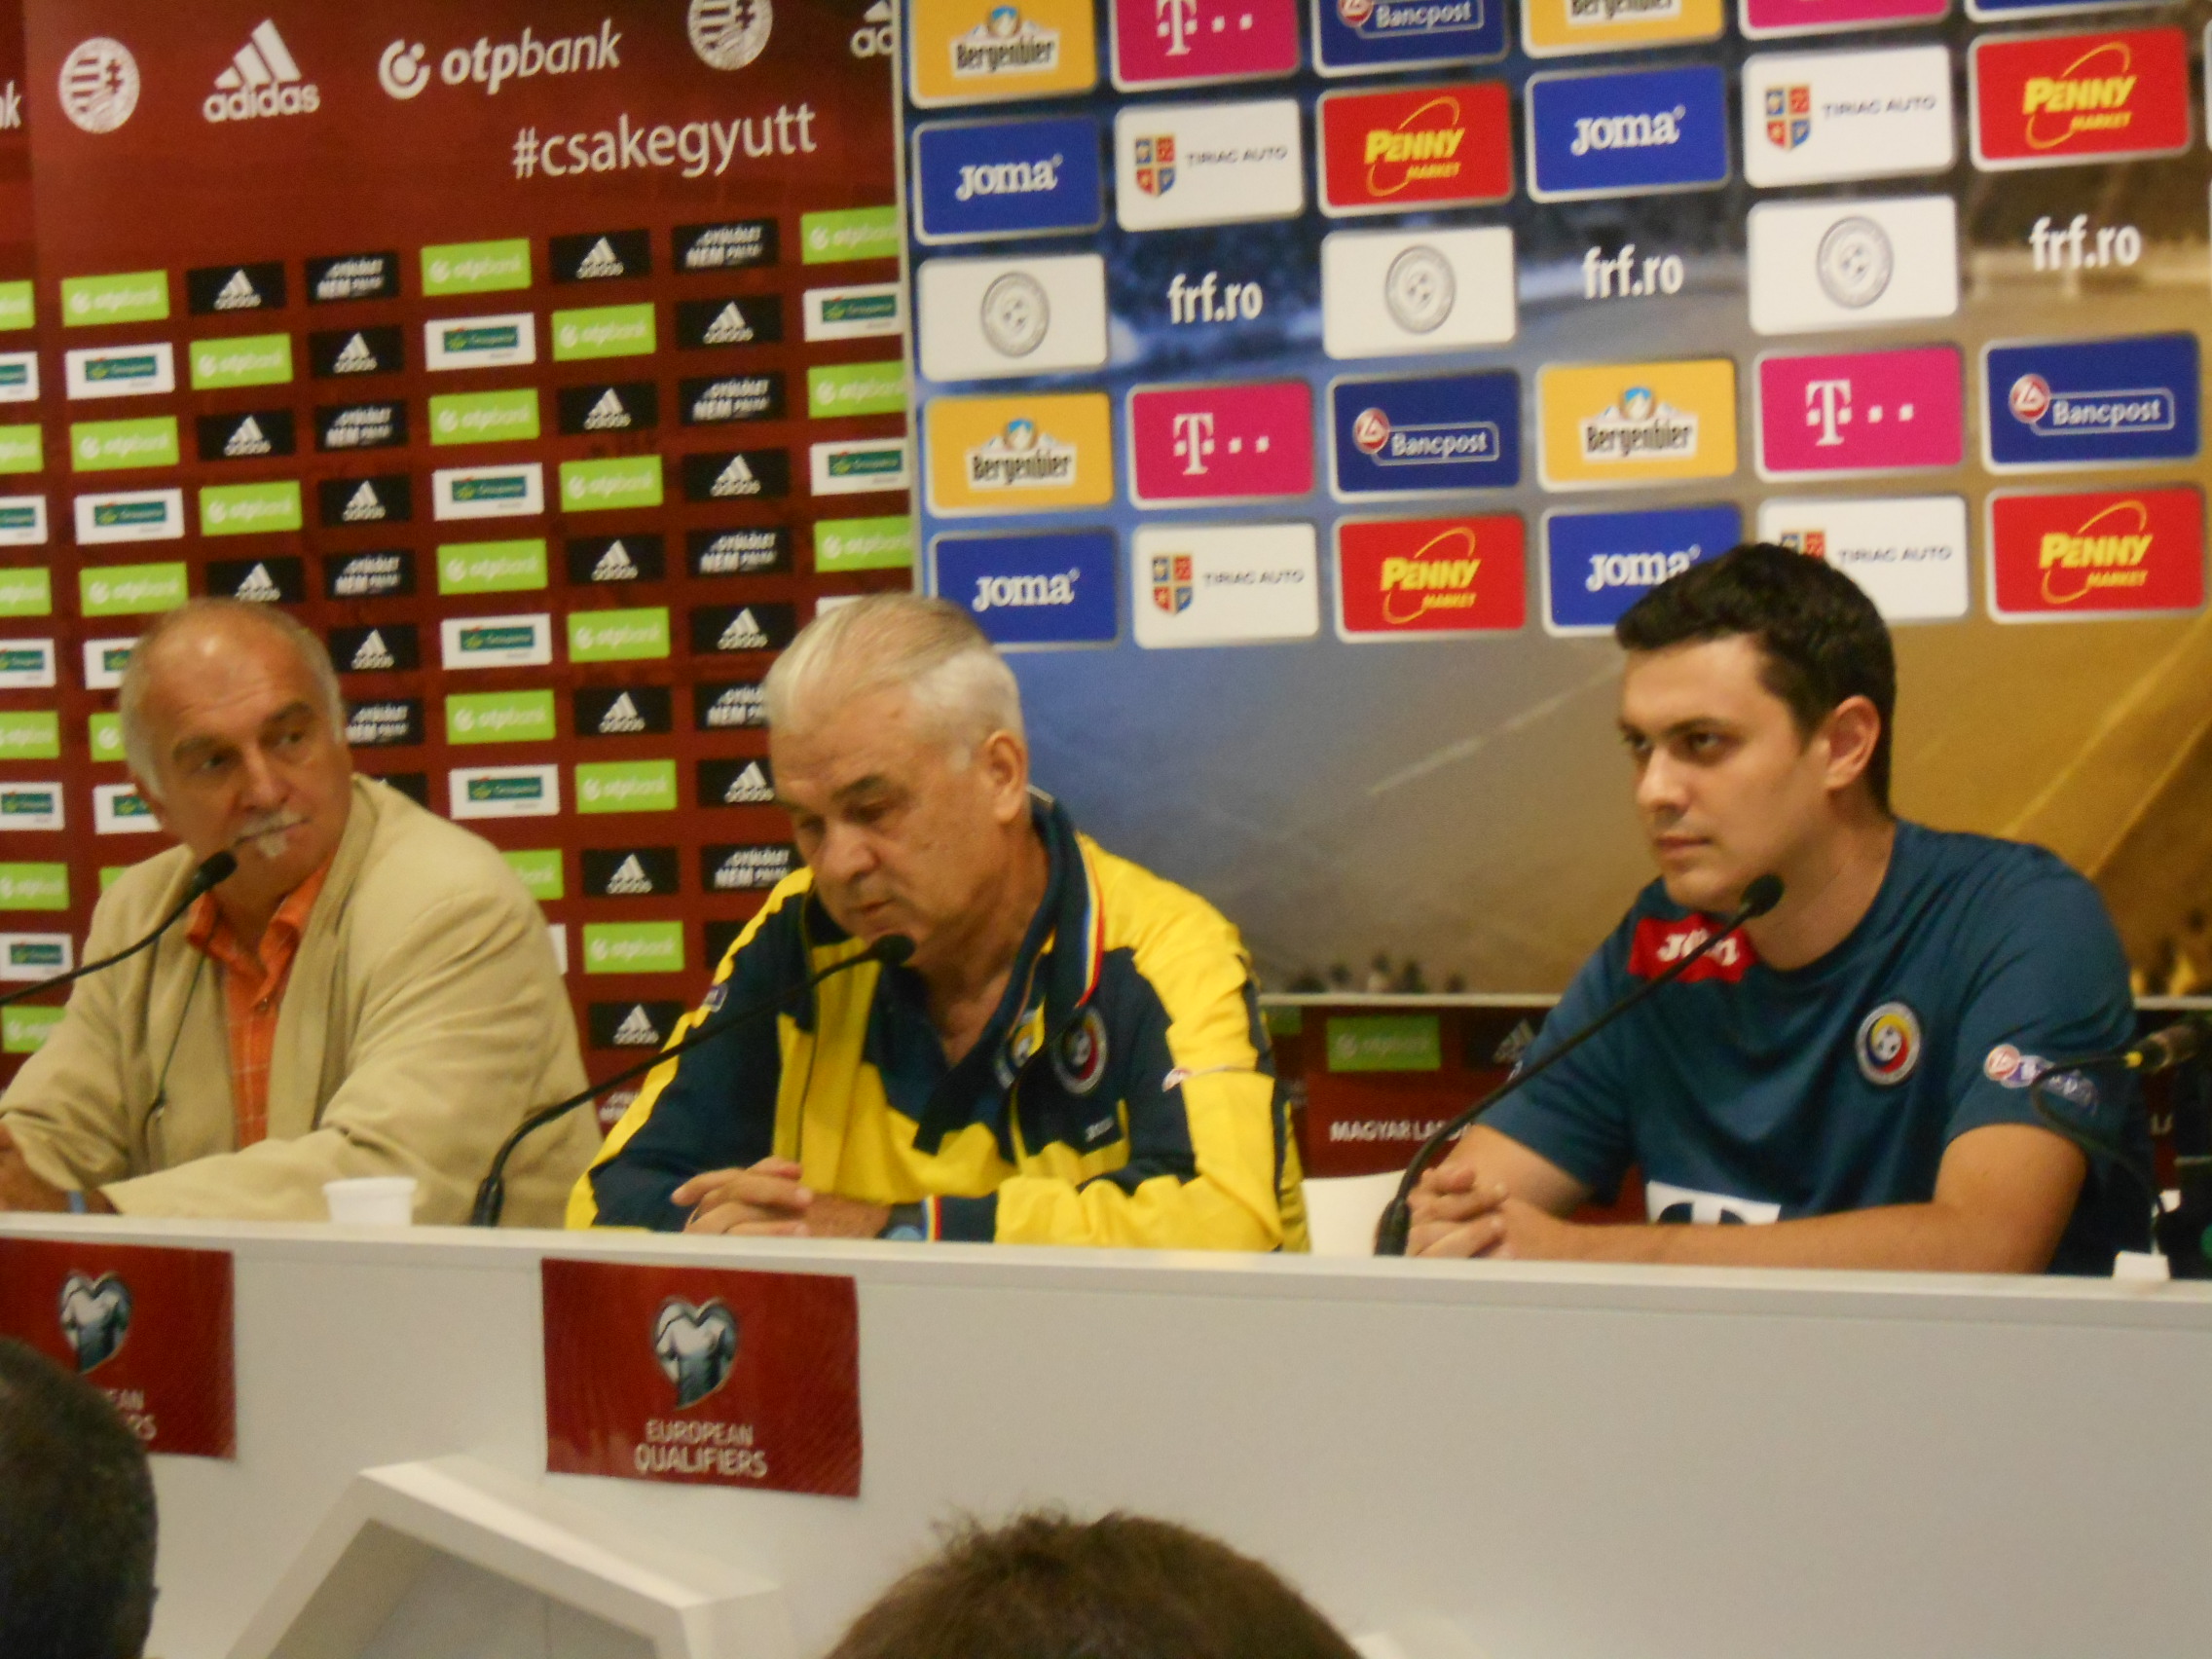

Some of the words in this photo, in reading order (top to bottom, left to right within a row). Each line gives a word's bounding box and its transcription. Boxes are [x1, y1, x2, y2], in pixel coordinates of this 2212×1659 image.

[441, 17, 622, 95] otpbank
[202, 84, 321, 123] adidas
[1886, 95, 1936, 114] AUTO
[511, 102, 818, 179] #csakegyutt
[1241, 146, 1288, 164] AUTO
[2029, 214, 2142, 272] frf.ro
[1582, 244, 1685, 299] frf.ro
[1167, 272, 1264, 325] frf.ro
[2051, 399, 2161, 428] Bancpost
[1390, 430, 1488, 460] Bancpost
[1900, 545, 1952, 563] AUTO
[1259, 568, 1306, 585] AUTO
[1329, 1121, 1412, 1143] MAGYAR
[645, 1419, 755, 1448] EUROPEAN
[633, 1443, 768, 1479] QUALIFIERS
